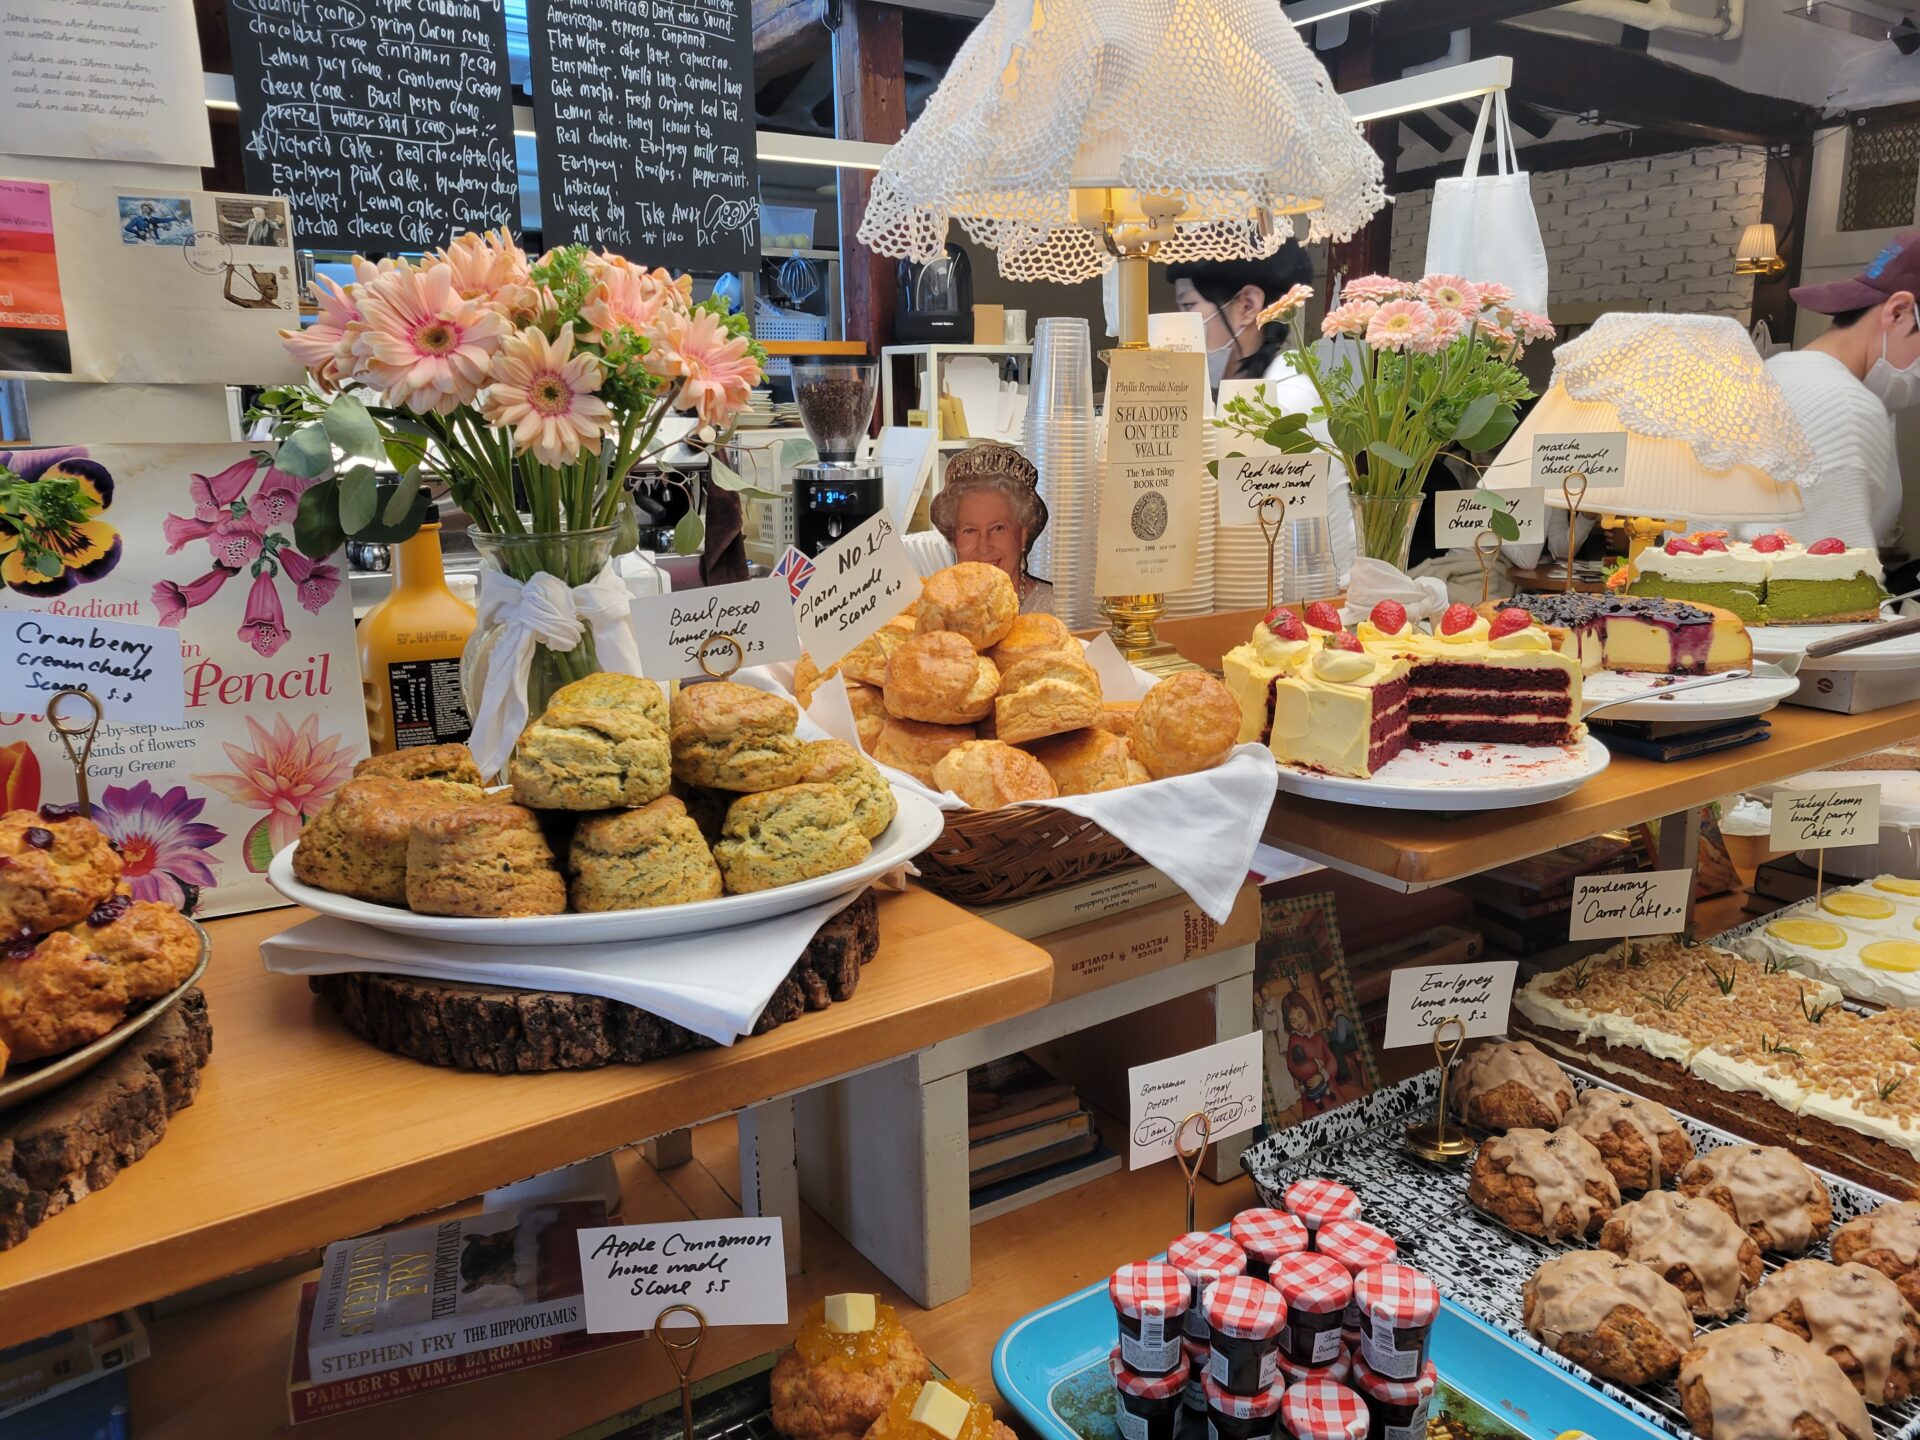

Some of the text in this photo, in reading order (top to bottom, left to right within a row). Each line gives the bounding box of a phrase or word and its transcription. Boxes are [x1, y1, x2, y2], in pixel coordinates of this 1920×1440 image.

[547, 28, 573, 51] Flat
[259, 42, 309, 70] Lemon
[260, 70, 306, 99] cheese
[555, 102, 592, 120] Lemon
[663, 118, 690, 134] lemon
[556, 126, 580, 144] Real
[396, 143, 424, 164] Real
[360, 190, 403, 214] Lemon
[1115, 381, 1190, 396] Phyllis Reynolds Naylor
[1115, 406, 1188, 423] SHADOWS
[1124, 424, 1179, 441] ON THE
[1133, 441, 1173, 458] WALL
[1537, 438, 1580, 452] matcha
[1543, 452, 1571, 461] home
[1126, 469, 1140, 478] The
[1236, 460, 1269, 480] Red
[1133, 480, 1169, 489] BOOK ONE
[1241, 479, 1280, 492] Cream
[1449, 516, 1484, 529] cheese
[47, 598, 140, 619] Radiant
[670, 597, 760, 627] Basil pesto
[180, 639, 202, 657] in
[184, 653, 332, 708] Pencil
[89, 736, 197, 758] kinds of flowers
[86, 758, 176, 780] Gary Greene
[1791, 812, 1819, 823] home
[1801, 824, 1832, 839] Cake
[1584, 900, 1626, 923] Carrot
[1630, 897, 1661, 918] Cake
[1183, 910, 1192, 962] UNUSUAL
[1191, 919, 1199, 950] MOST
[1071, 936, 1169, 972] FELTON FOWLER
[591, 1233, 772, 1260] Apple Cinnamon
[386, 1251, 432, 1302] FRY
[432, 1221, 463, 1321] THE HIPPOPOTAMUS
[608, 1252, 729, 1279] home made
[339, 1236, 387, 1338] STEPHEN
[631, 1278, 692, 1296] Scone
[321, 1341, 414, 1375] STEPHEN
[422, 1332, 457, 1355] FRY
[463, 1324, 489, 1344] THE
[407, 1357, 458, 1384] WINE
[464, 1335, 554, 1369] BARGAINS
